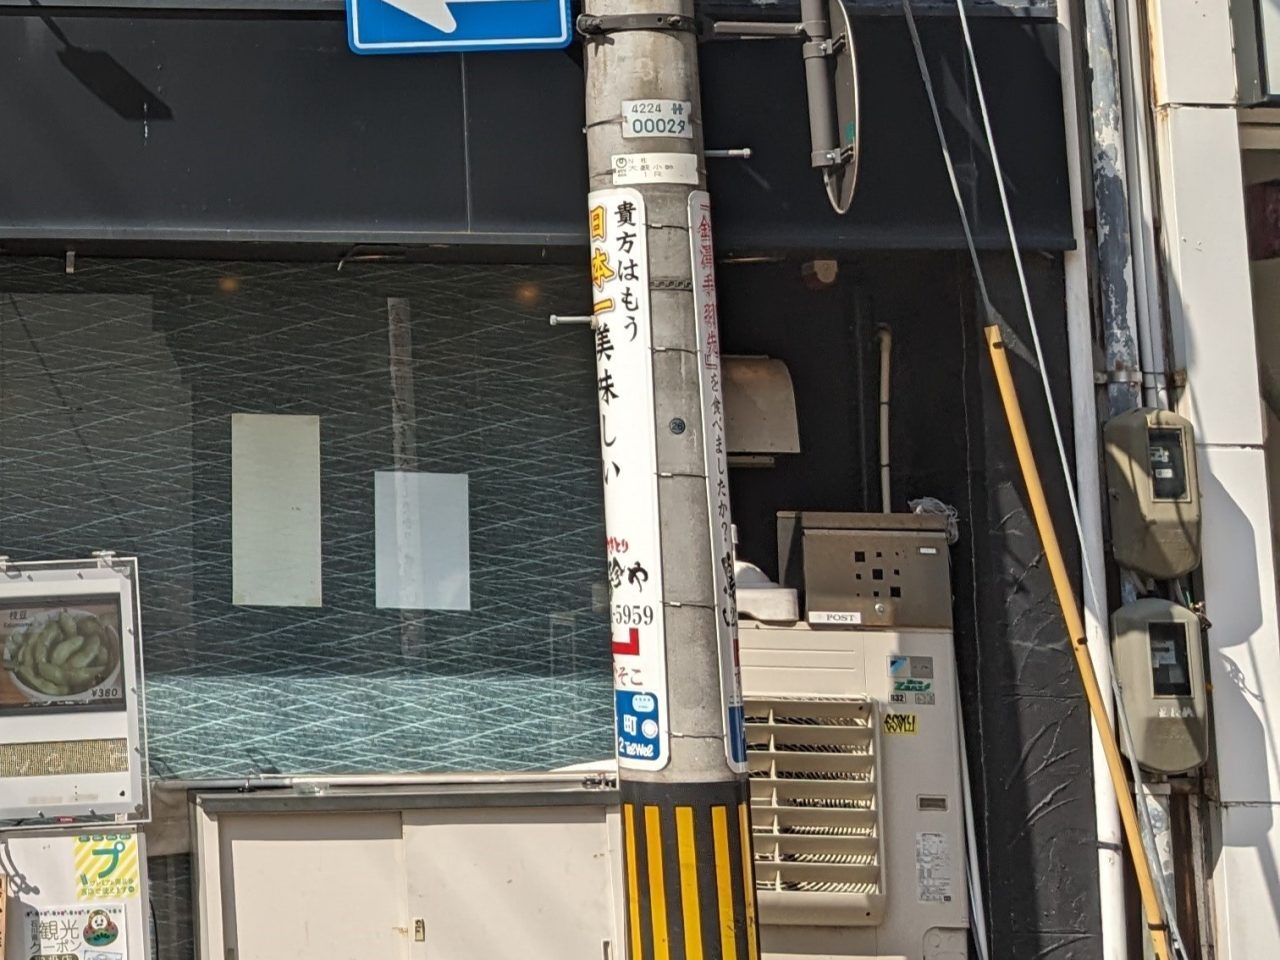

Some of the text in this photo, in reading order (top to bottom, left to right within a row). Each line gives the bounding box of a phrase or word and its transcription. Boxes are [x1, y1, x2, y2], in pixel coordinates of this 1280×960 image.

[631, 103, 662, 114] 4224
[614, 200, 640, 342] 貴方はもう
[826, 614, 855, 622] POST
[39, 919, 80, 941] 観光
[30, 940, 82, 955] クーポン
